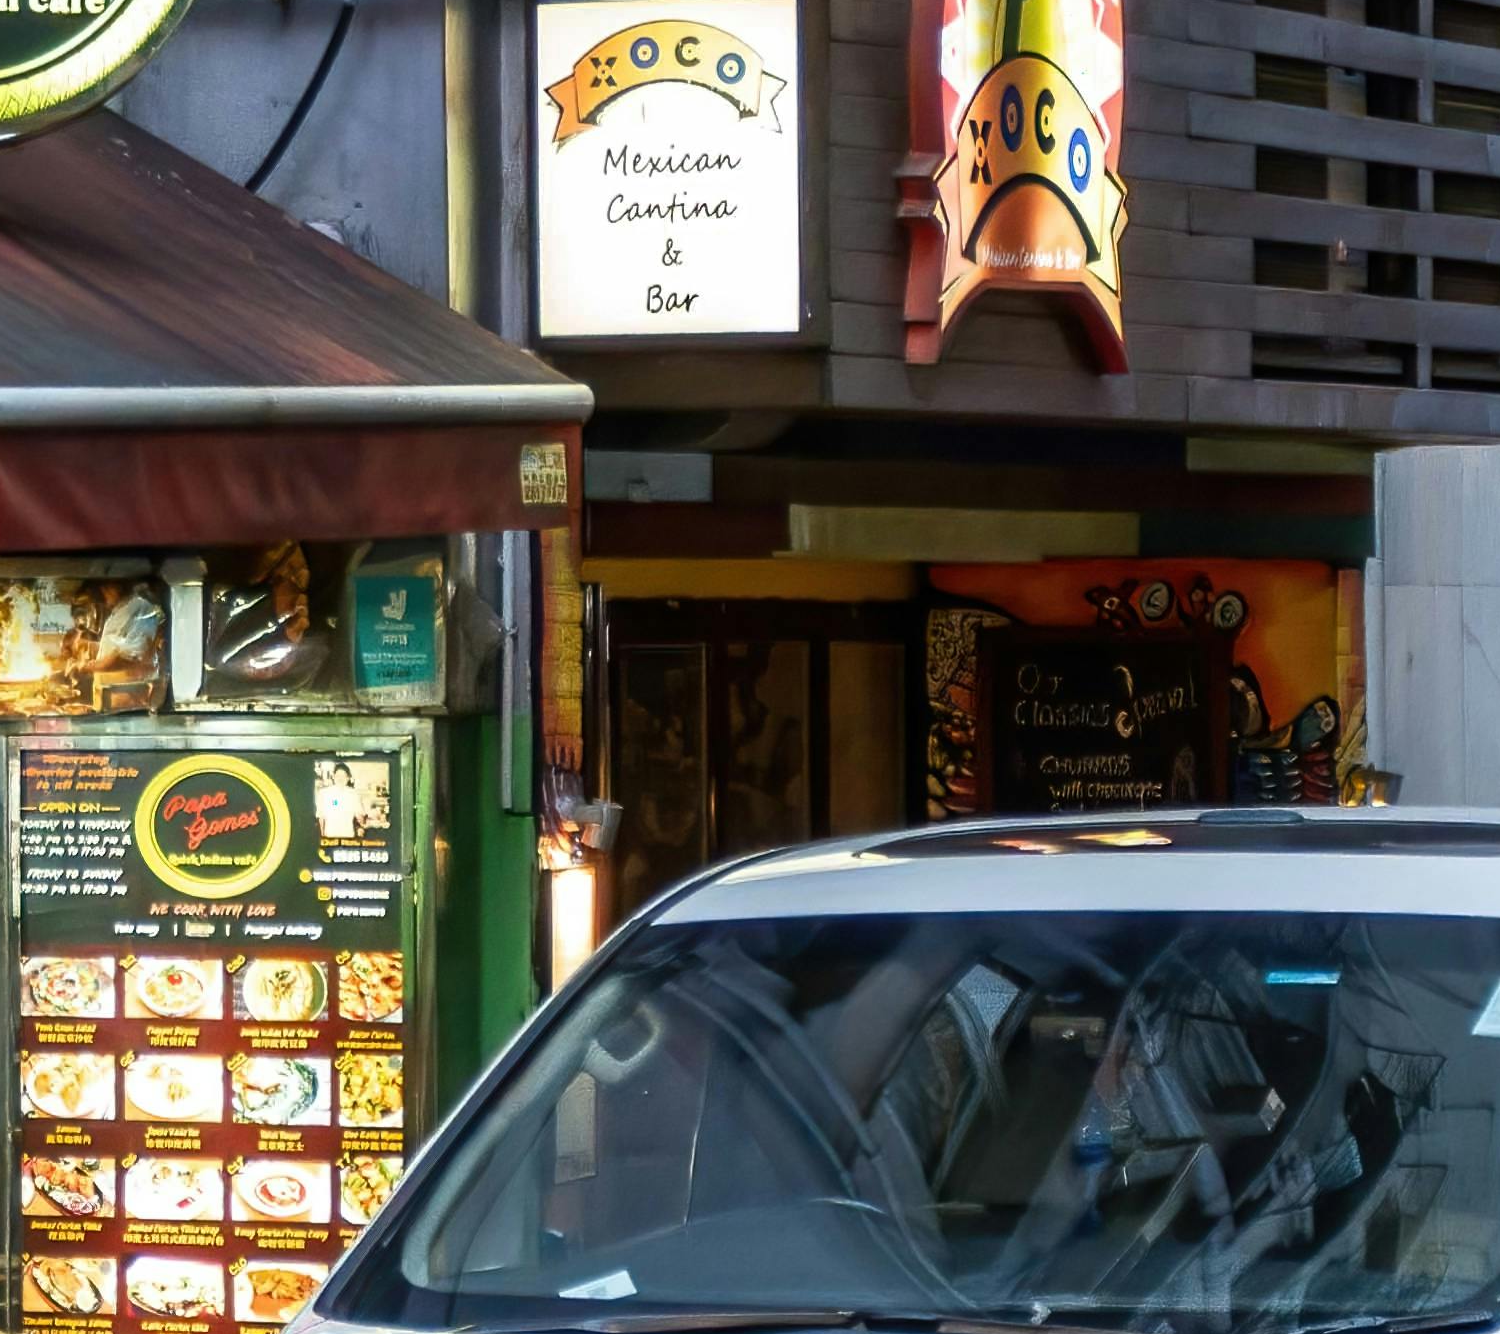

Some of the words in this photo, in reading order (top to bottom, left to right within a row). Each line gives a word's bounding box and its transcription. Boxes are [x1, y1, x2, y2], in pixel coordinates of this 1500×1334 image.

[590, 37, 746, 88] XOCO
[969, 83, 1091, 194] XOCO
[603, 144, 741, 177] Mexican
[607, 191, 737, 224] Cantina
[662, 238, 682, 267] &
[646, 284, 700, 314] Bar
[39, 802, 76, 813] OPEN
[78, 802, 101, 813] ON
[163, 791, 228, 821] Papa
